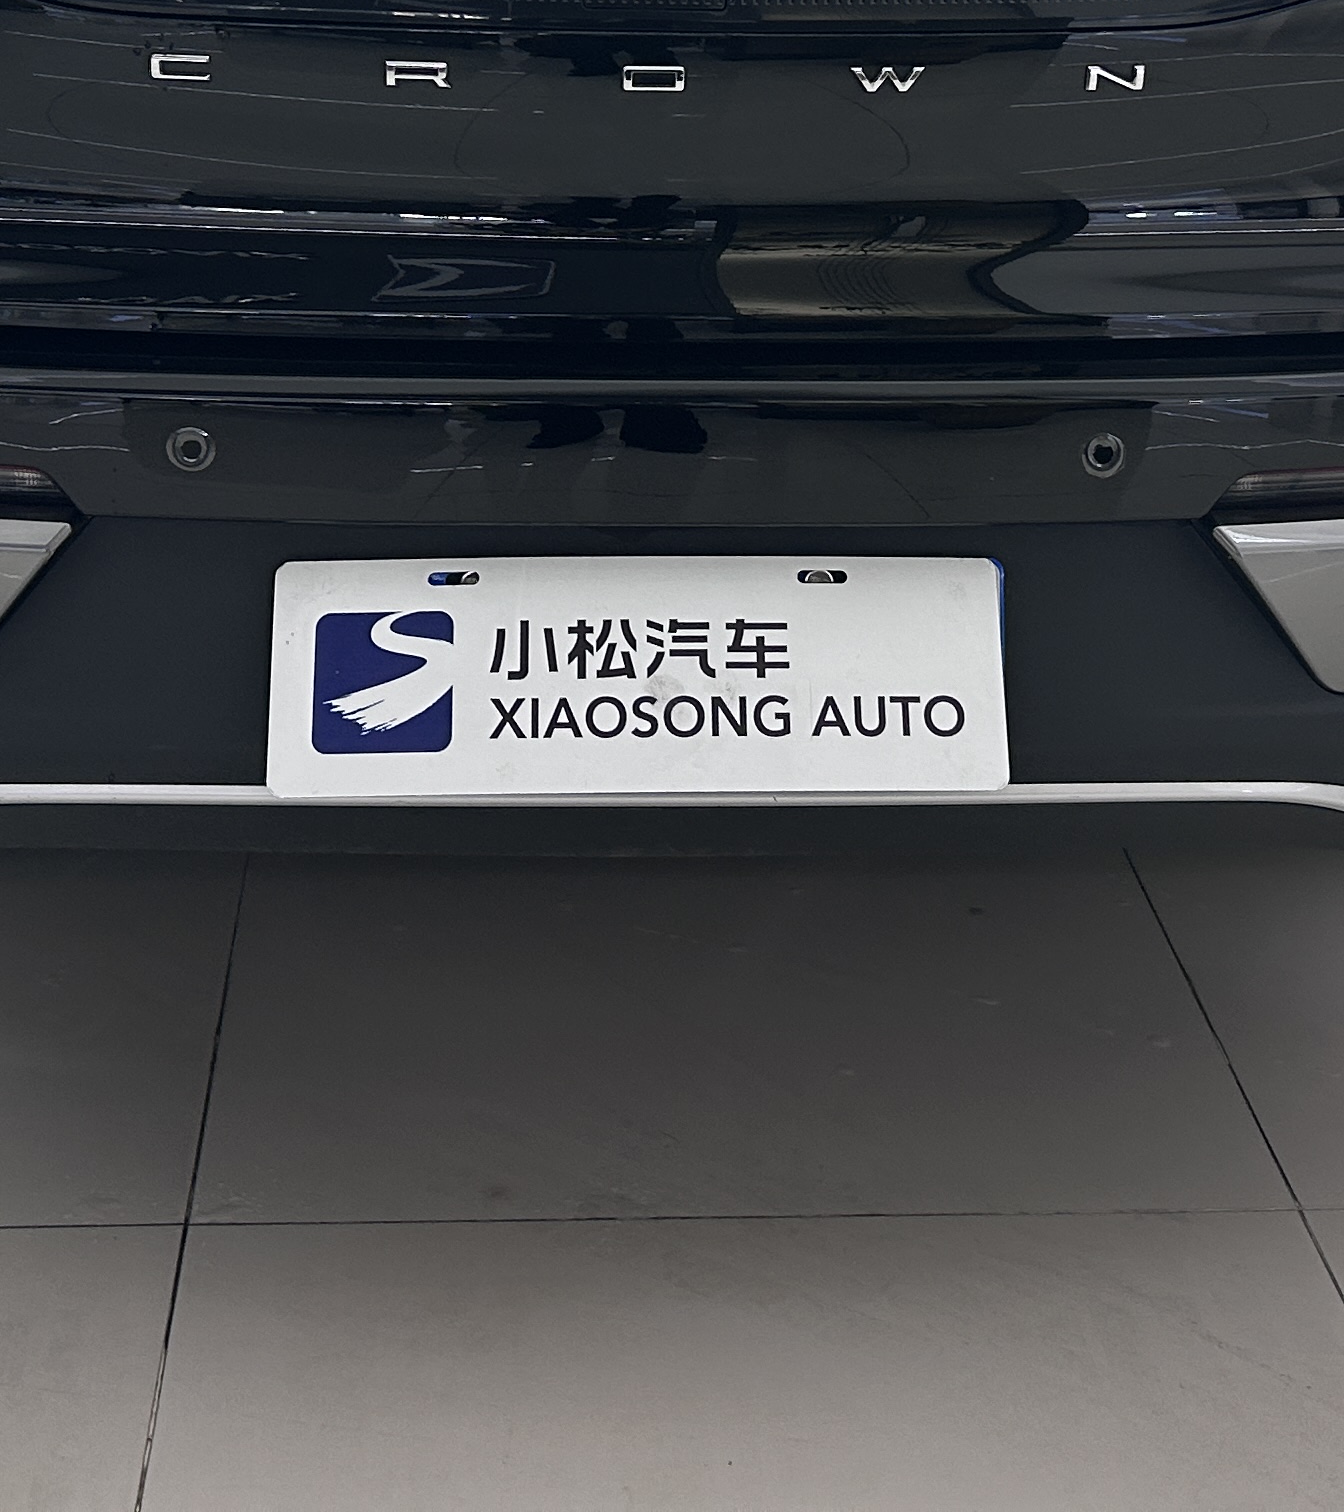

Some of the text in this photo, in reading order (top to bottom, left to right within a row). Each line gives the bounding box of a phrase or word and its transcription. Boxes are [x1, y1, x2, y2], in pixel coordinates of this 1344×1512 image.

[150, 53, 1146, 94] CROWN
[489, 618, 791, 681] 小松汽车
[489, 695, 966, 740] XIAOSONG AUTO
